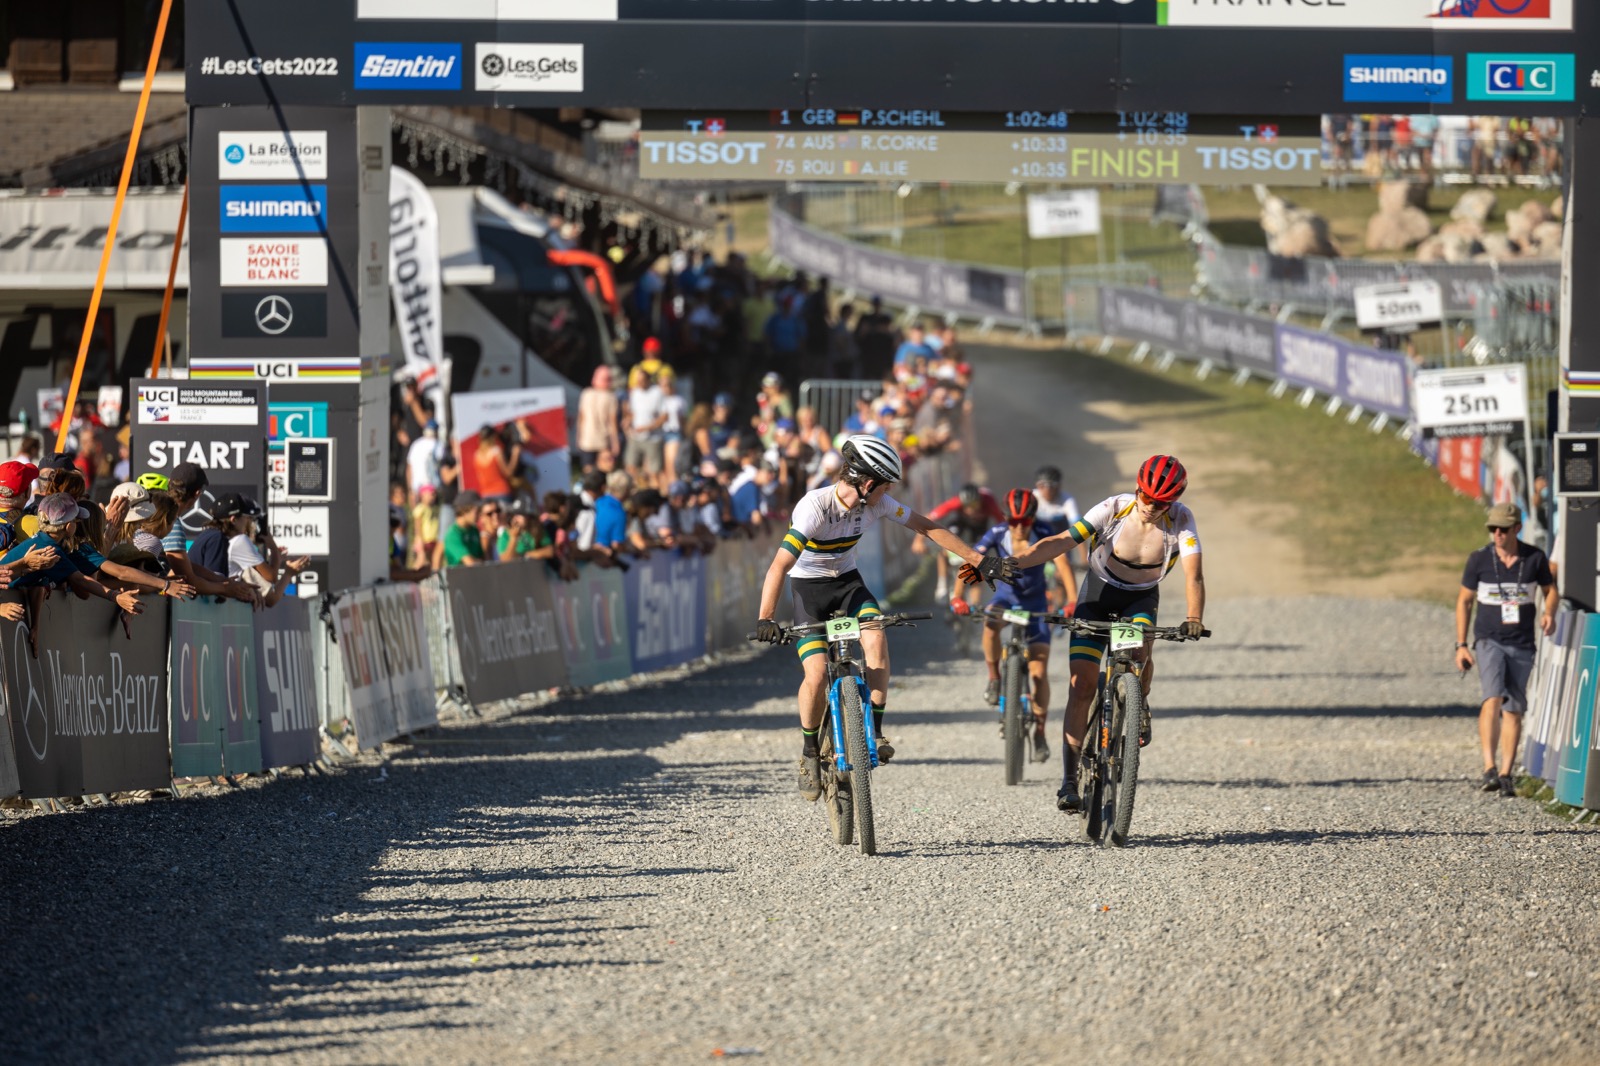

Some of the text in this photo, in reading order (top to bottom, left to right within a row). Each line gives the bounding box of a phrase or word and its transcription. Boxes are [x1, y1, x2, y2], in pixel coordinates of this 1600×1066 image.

[201, 57, 338, 76] #LesGets2022
[361, 55, 456, 78] Santini
[507, 57, 578, 73] Les Gets
[1350, 67, 1447, 84] SHIMANO
[1493, 67, 1549, 88] CIC
[780, 111, 1068, 127] 1 GER P.SCHEHL 1:02:48
[249, 142, 322, 159] La Région
[775, 135, 795, 149] 74
[802, 135, 835, 150] AUS
[861, 135, 939, 151] R.CORKE
[644, 141, 766, 164] TISSOT
[1196, 147, 1319, 171] TISSOT
[775, 160, 795, 175] 75
[802, 160, 835, 175] ROU
[1071, 149, 1179, 178] FINISH
[226, 201, 321, 217] SHIMANO
[247, 244, 300, 255] SAVOIE
[247, 256, 289, 267] MONT
[247, 269, 300, 280] BLANC
[257, 364, 293, 378] UCI
[145, 391, 174, 402] UCI
[1444, 393, 1499, 415] 25m
[148, 441, 250, 469] START
[270, 523, 323, 538] ENCAL
[833, 621, 852, 631] 89
[1118, 628, 1136, 639] 73
[46, 649, 160, 737] Mercedes-Benz
